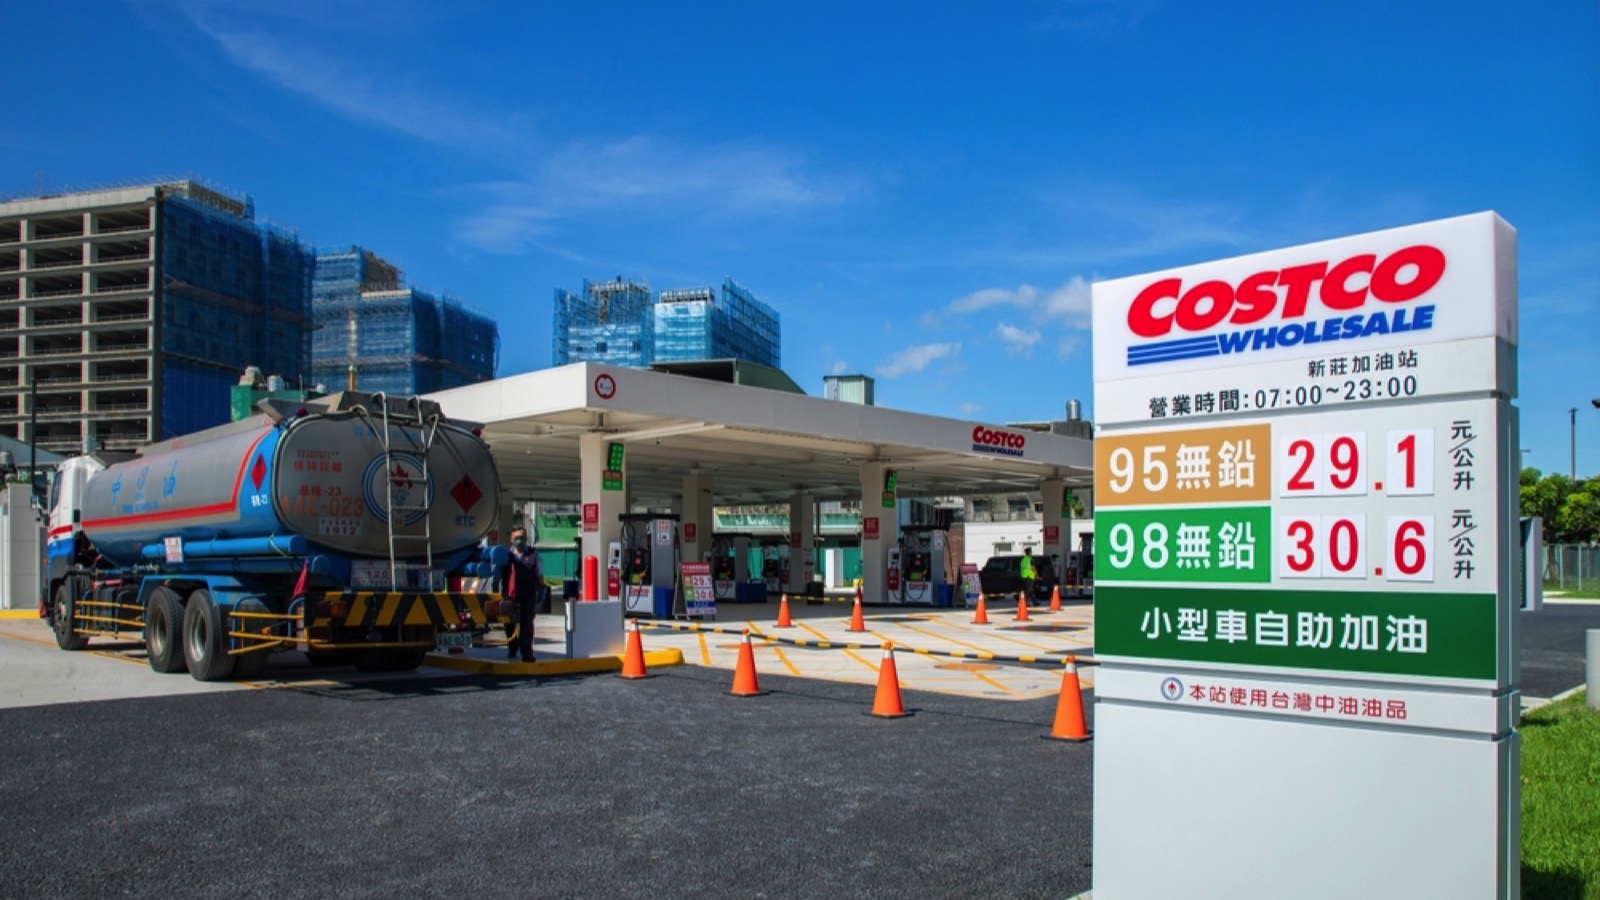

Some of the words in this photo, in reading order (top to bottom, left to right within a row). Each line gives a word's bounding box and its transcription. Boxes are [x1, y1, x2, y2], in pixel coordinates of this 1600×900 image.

[1127, 245, 1446, 338] COSTCO
[1218, 304, 1436, 355] WHOLESALE
[1308, 350, 1418, 379] 新莊加油站
[972, 425, 1025, 448] COSTCO
[1110, 439, 1256, 493] 95無鉛
[1287, 435, 1416, 490] 29.1
[1110, 522, 1256, 570] 98無鉛
[1287, 519, 1426, 576] 30.6
[1140, 607, 1428, 654] 小型車自助加油
[1189, 684, 1407, 719] 本站使用台灣中油油品
